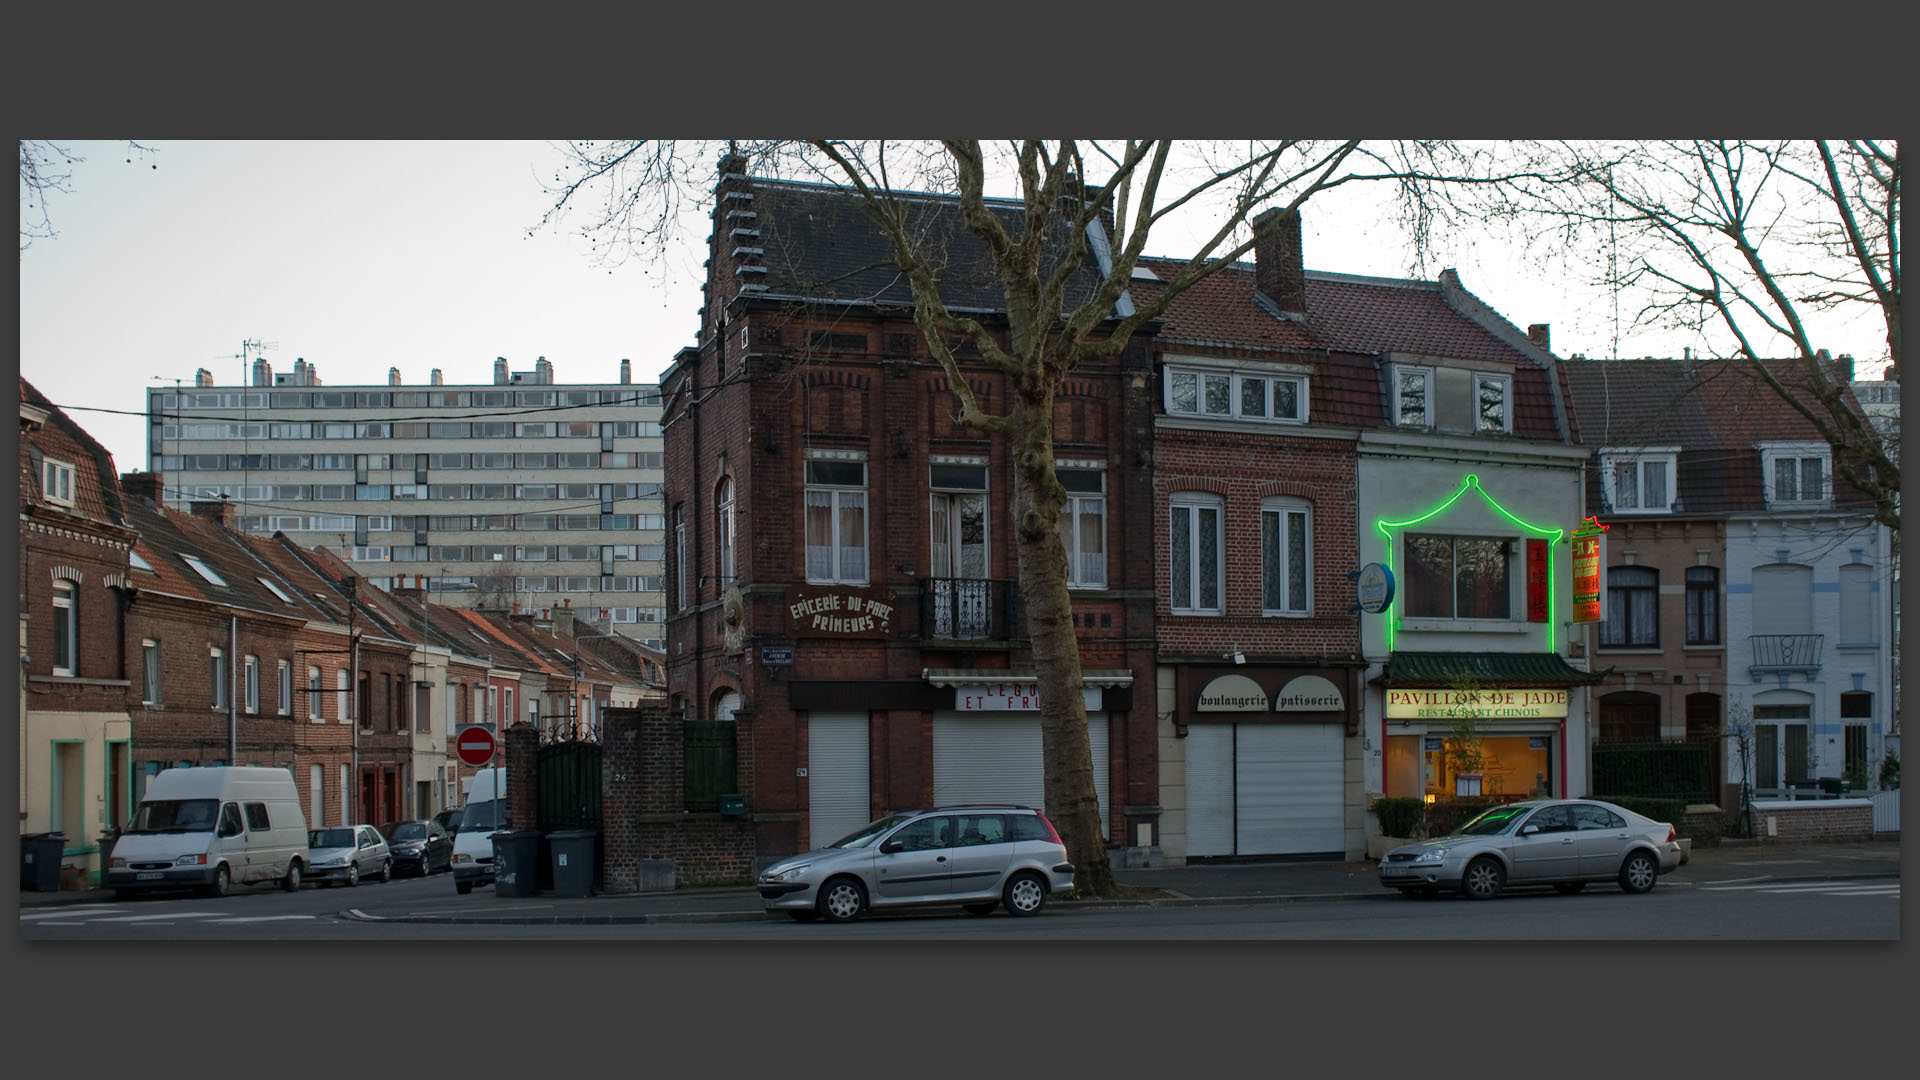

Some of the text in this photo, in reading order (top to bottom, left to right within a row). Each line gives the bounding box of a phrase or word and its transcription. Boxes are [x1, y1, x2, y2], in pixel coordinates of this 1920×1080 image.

[812, 614, 875, 633] PRIMEURS
[966, 696, 984, 709] ET
[1201, 694, 1265, 708] boulangerie
[1281, 694, 1339, 708] patisserie
[1389, 692, 1566, 706] PAVILLON DE JADE
[1418, 708, 1540, 717] RESTAURANT CHINOIS
